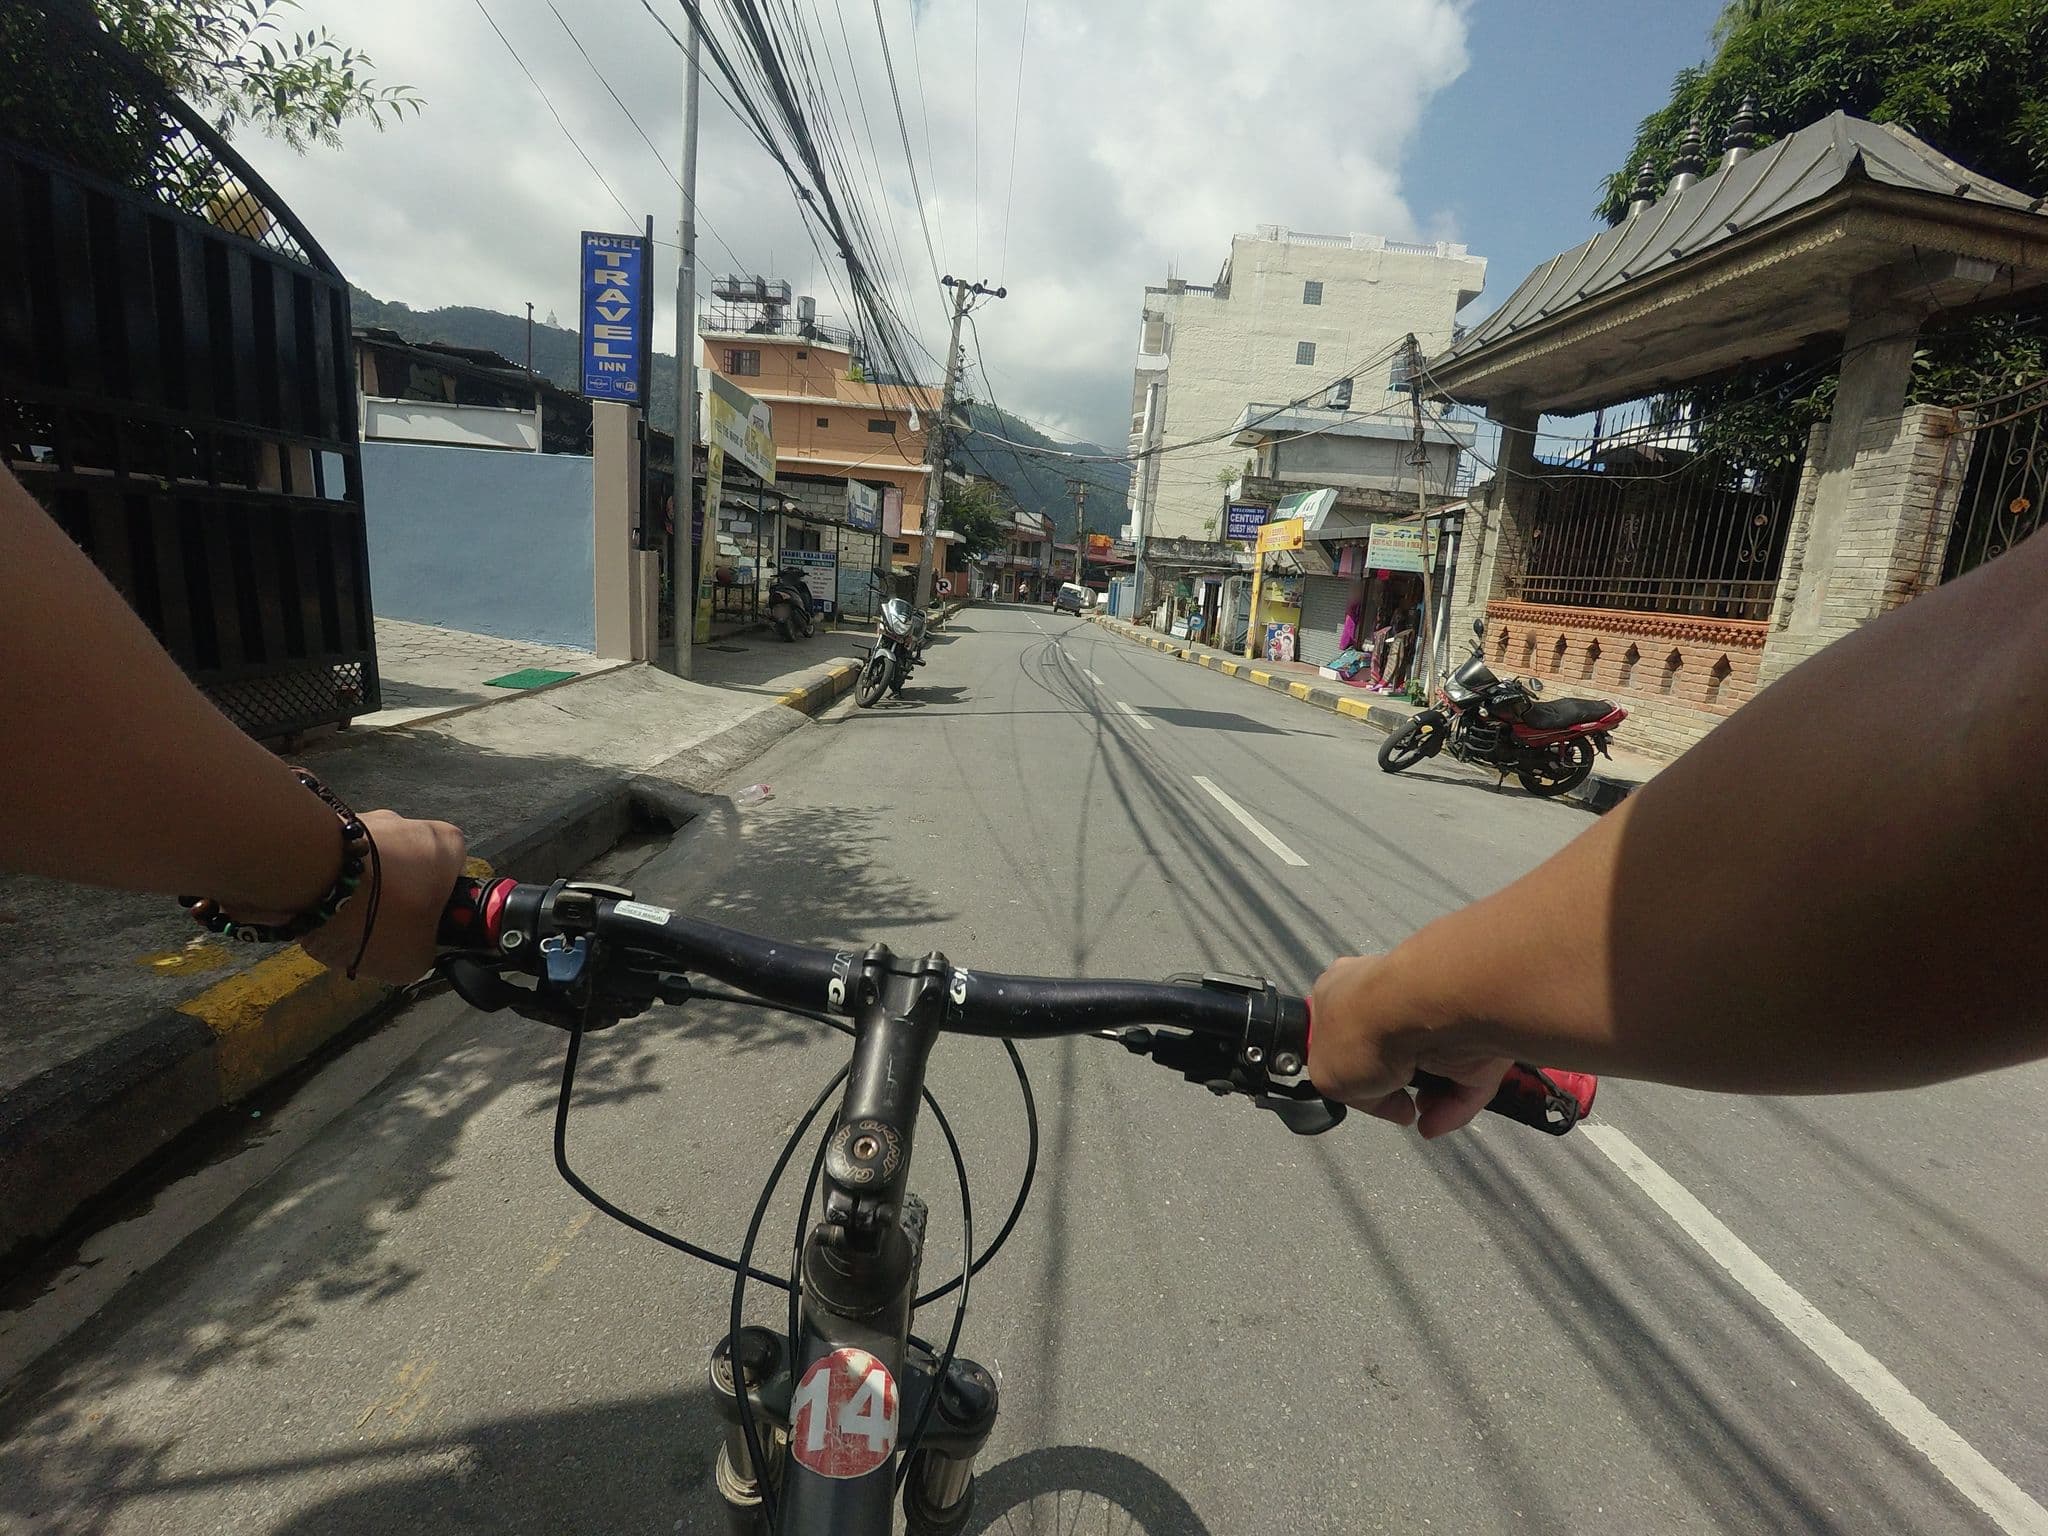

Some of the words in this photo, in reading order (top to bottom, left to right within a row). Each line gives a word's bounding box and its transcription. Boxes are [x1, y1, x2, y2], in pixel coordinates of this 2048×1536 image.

[587, 236, 641, 250] HOTEL
[593, 250, 633, 359] TRAVEL
[598, 361, 626, 372] INN
[1230, 513, 1266, 524] CENTURY
[1228, 524, 1246, 534] GUEST
[1246, 525, 1258, 535] HOU
[1189, 616, 1201, 629] P
[790, 1368, 896, 1453] 14
